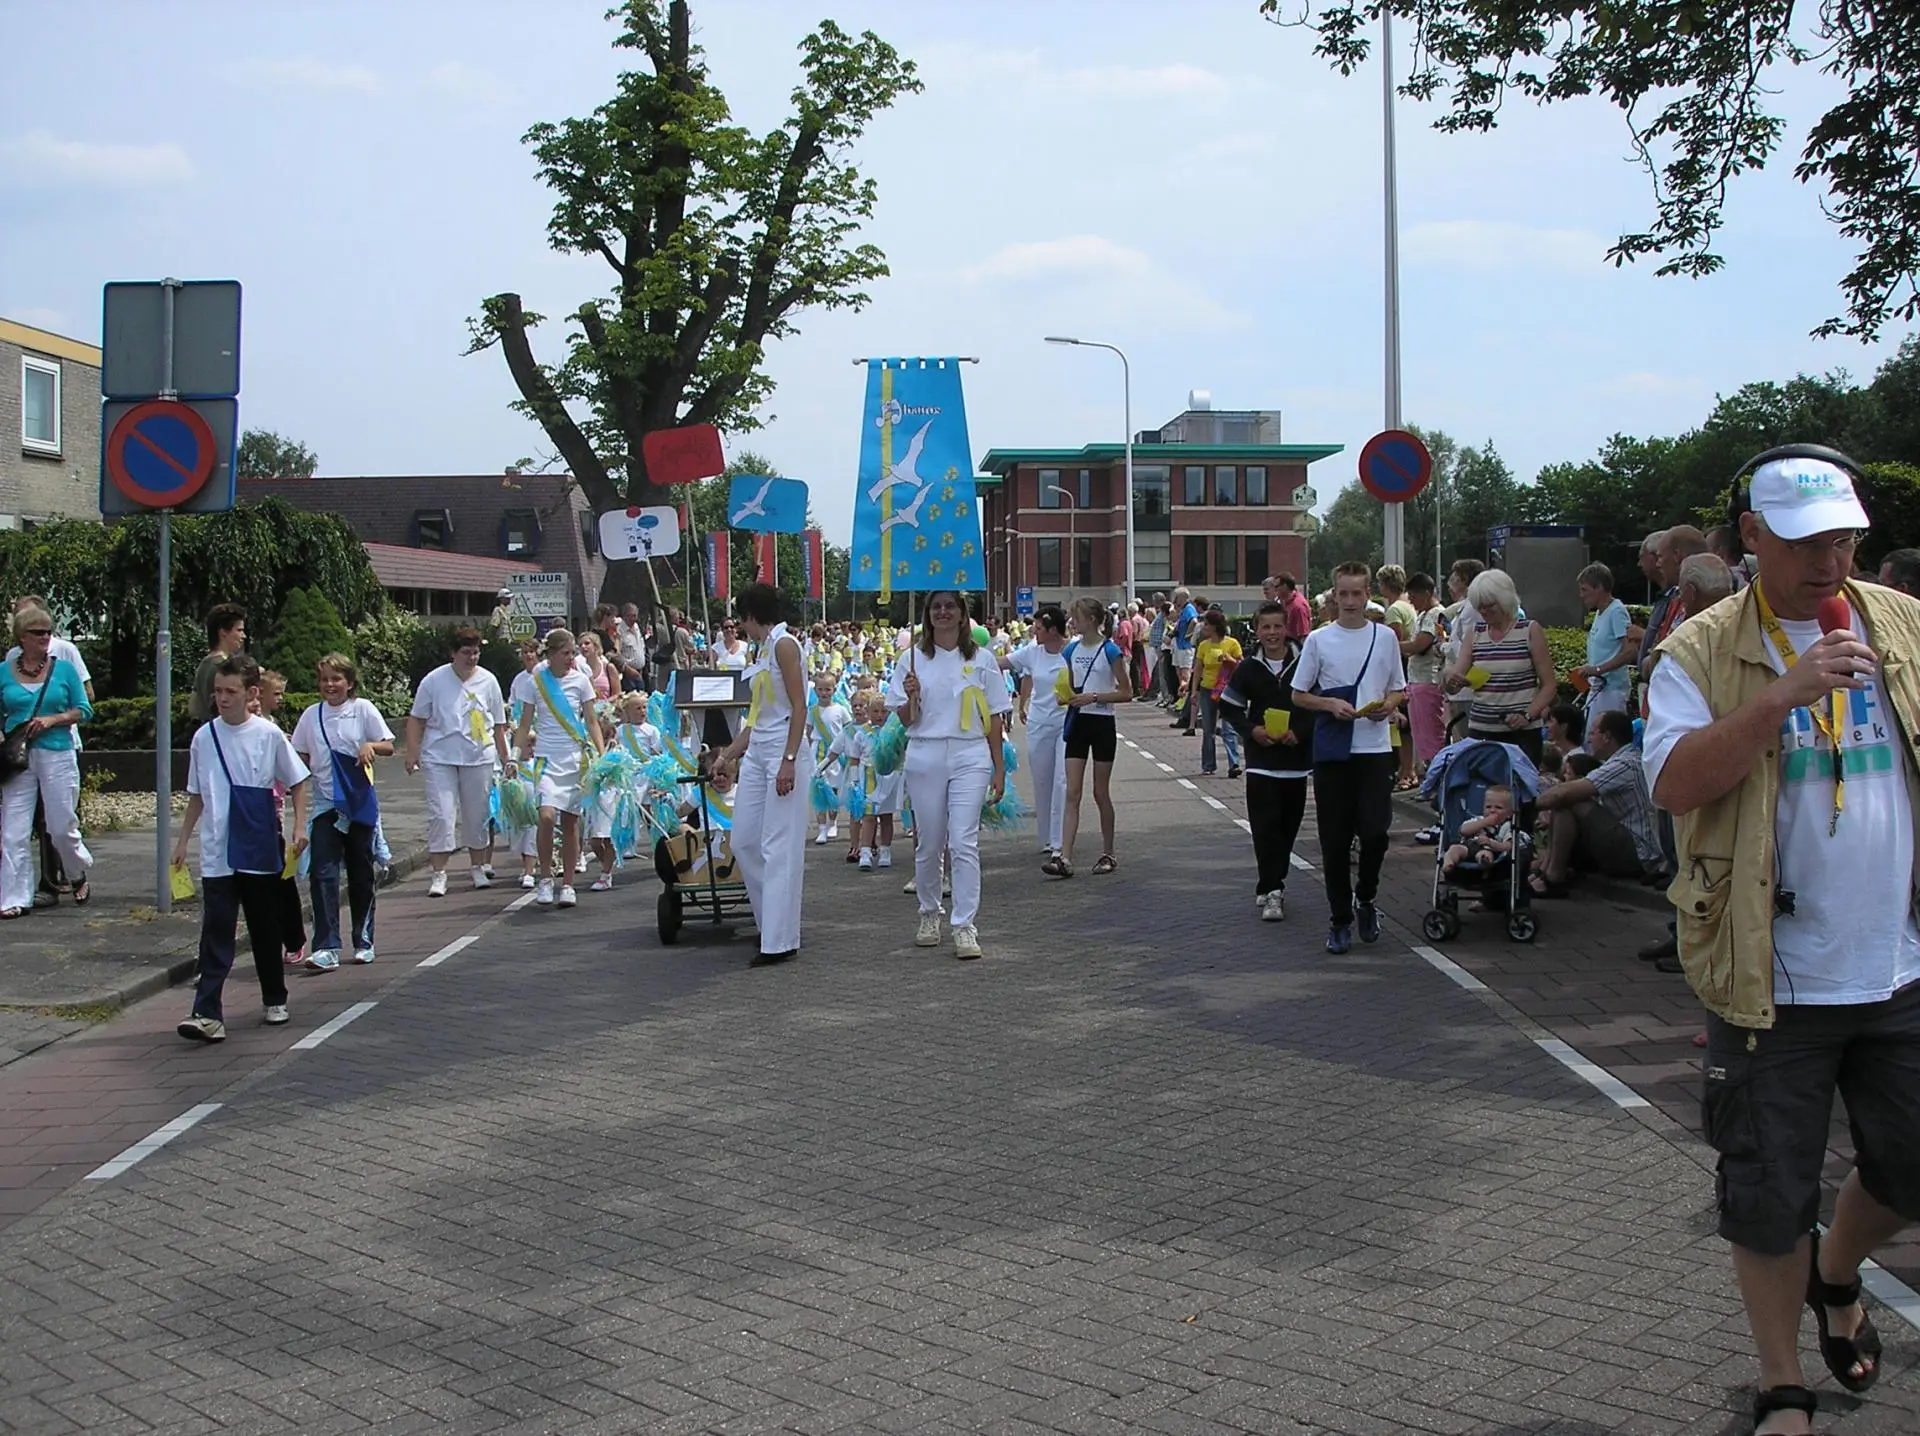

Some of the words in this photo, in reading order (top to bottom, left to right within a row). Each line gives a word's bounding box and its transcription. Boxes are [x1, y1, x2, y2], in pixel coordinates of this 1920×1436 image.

[511, 574, 525, 583] TE
[529, 574, 562, 583] HUUR
[513, 622, 532, 634] ZIT
